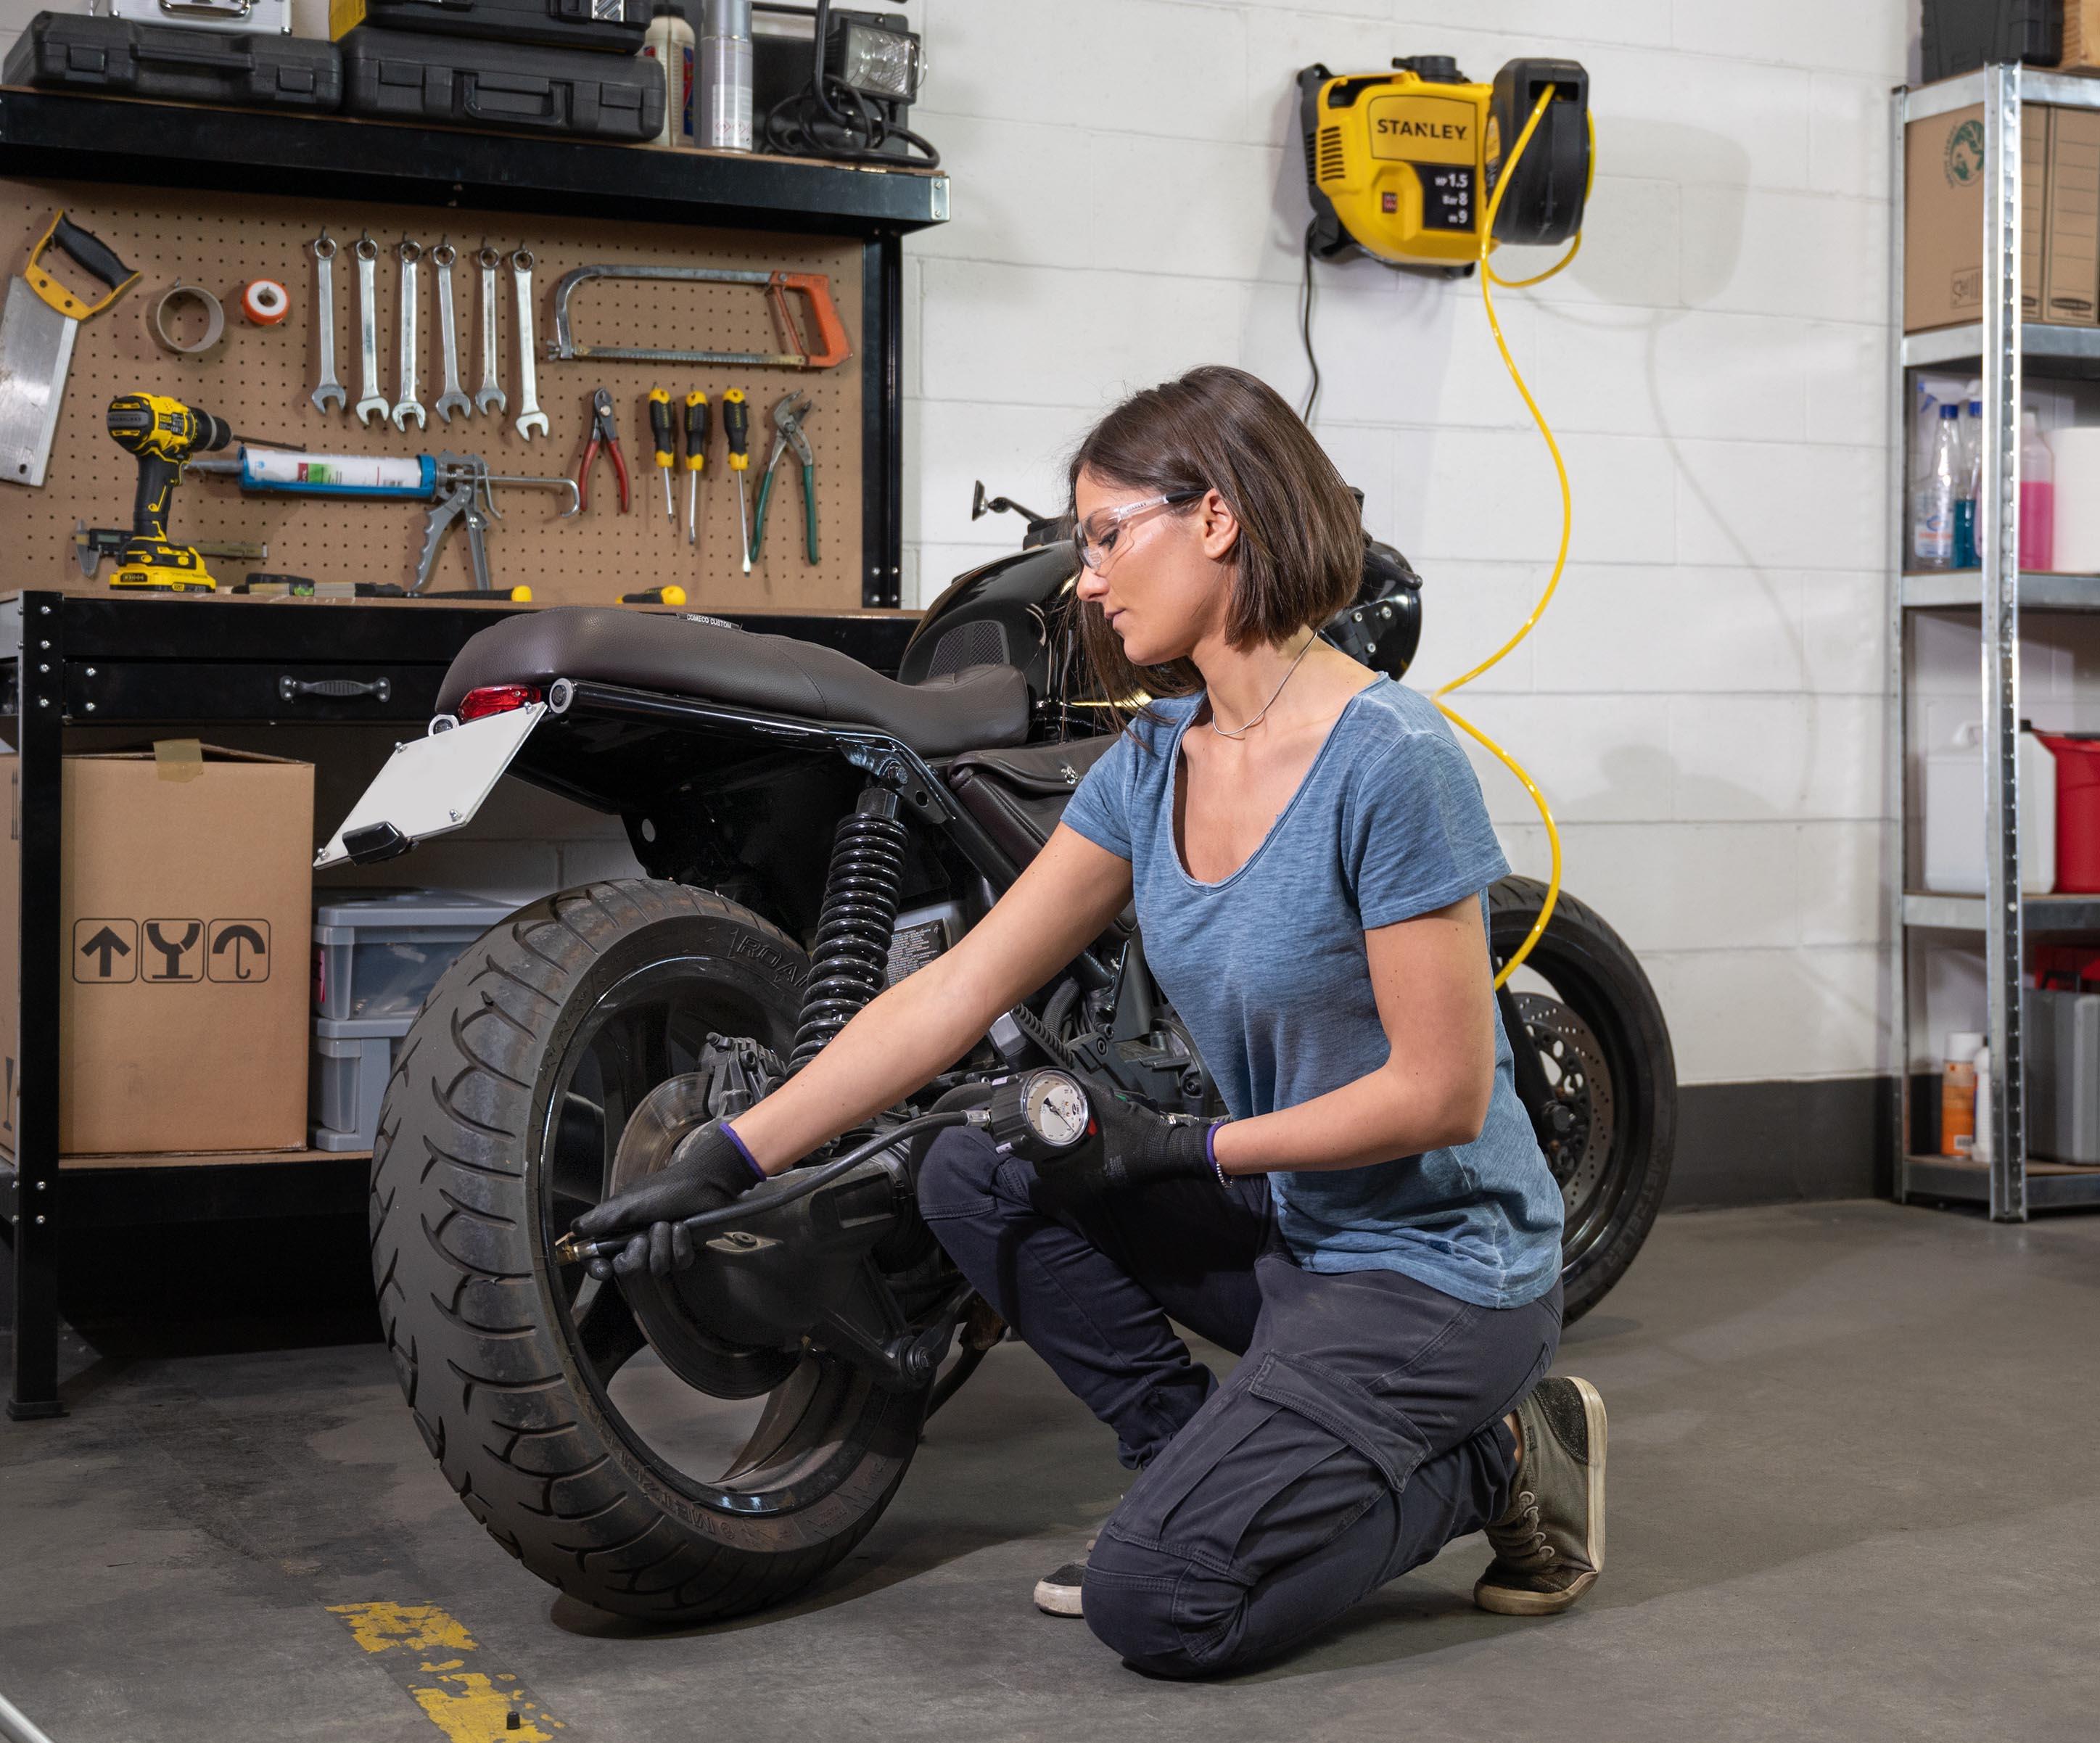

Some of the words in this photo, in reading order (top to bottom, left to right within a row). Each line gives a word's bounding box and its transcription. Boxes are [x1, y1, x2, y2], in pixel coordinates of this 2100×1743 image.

[1377, 118, 1467, 140] STANLEY
[1449, 172, 1469, 189] 1.5
[1458, 191, 1469, 206] 8
[1458, 209, 1467, 224] 9
[686, 614, 709, 624] COMECO
[710, 618, 732, 629] CUSTOM
